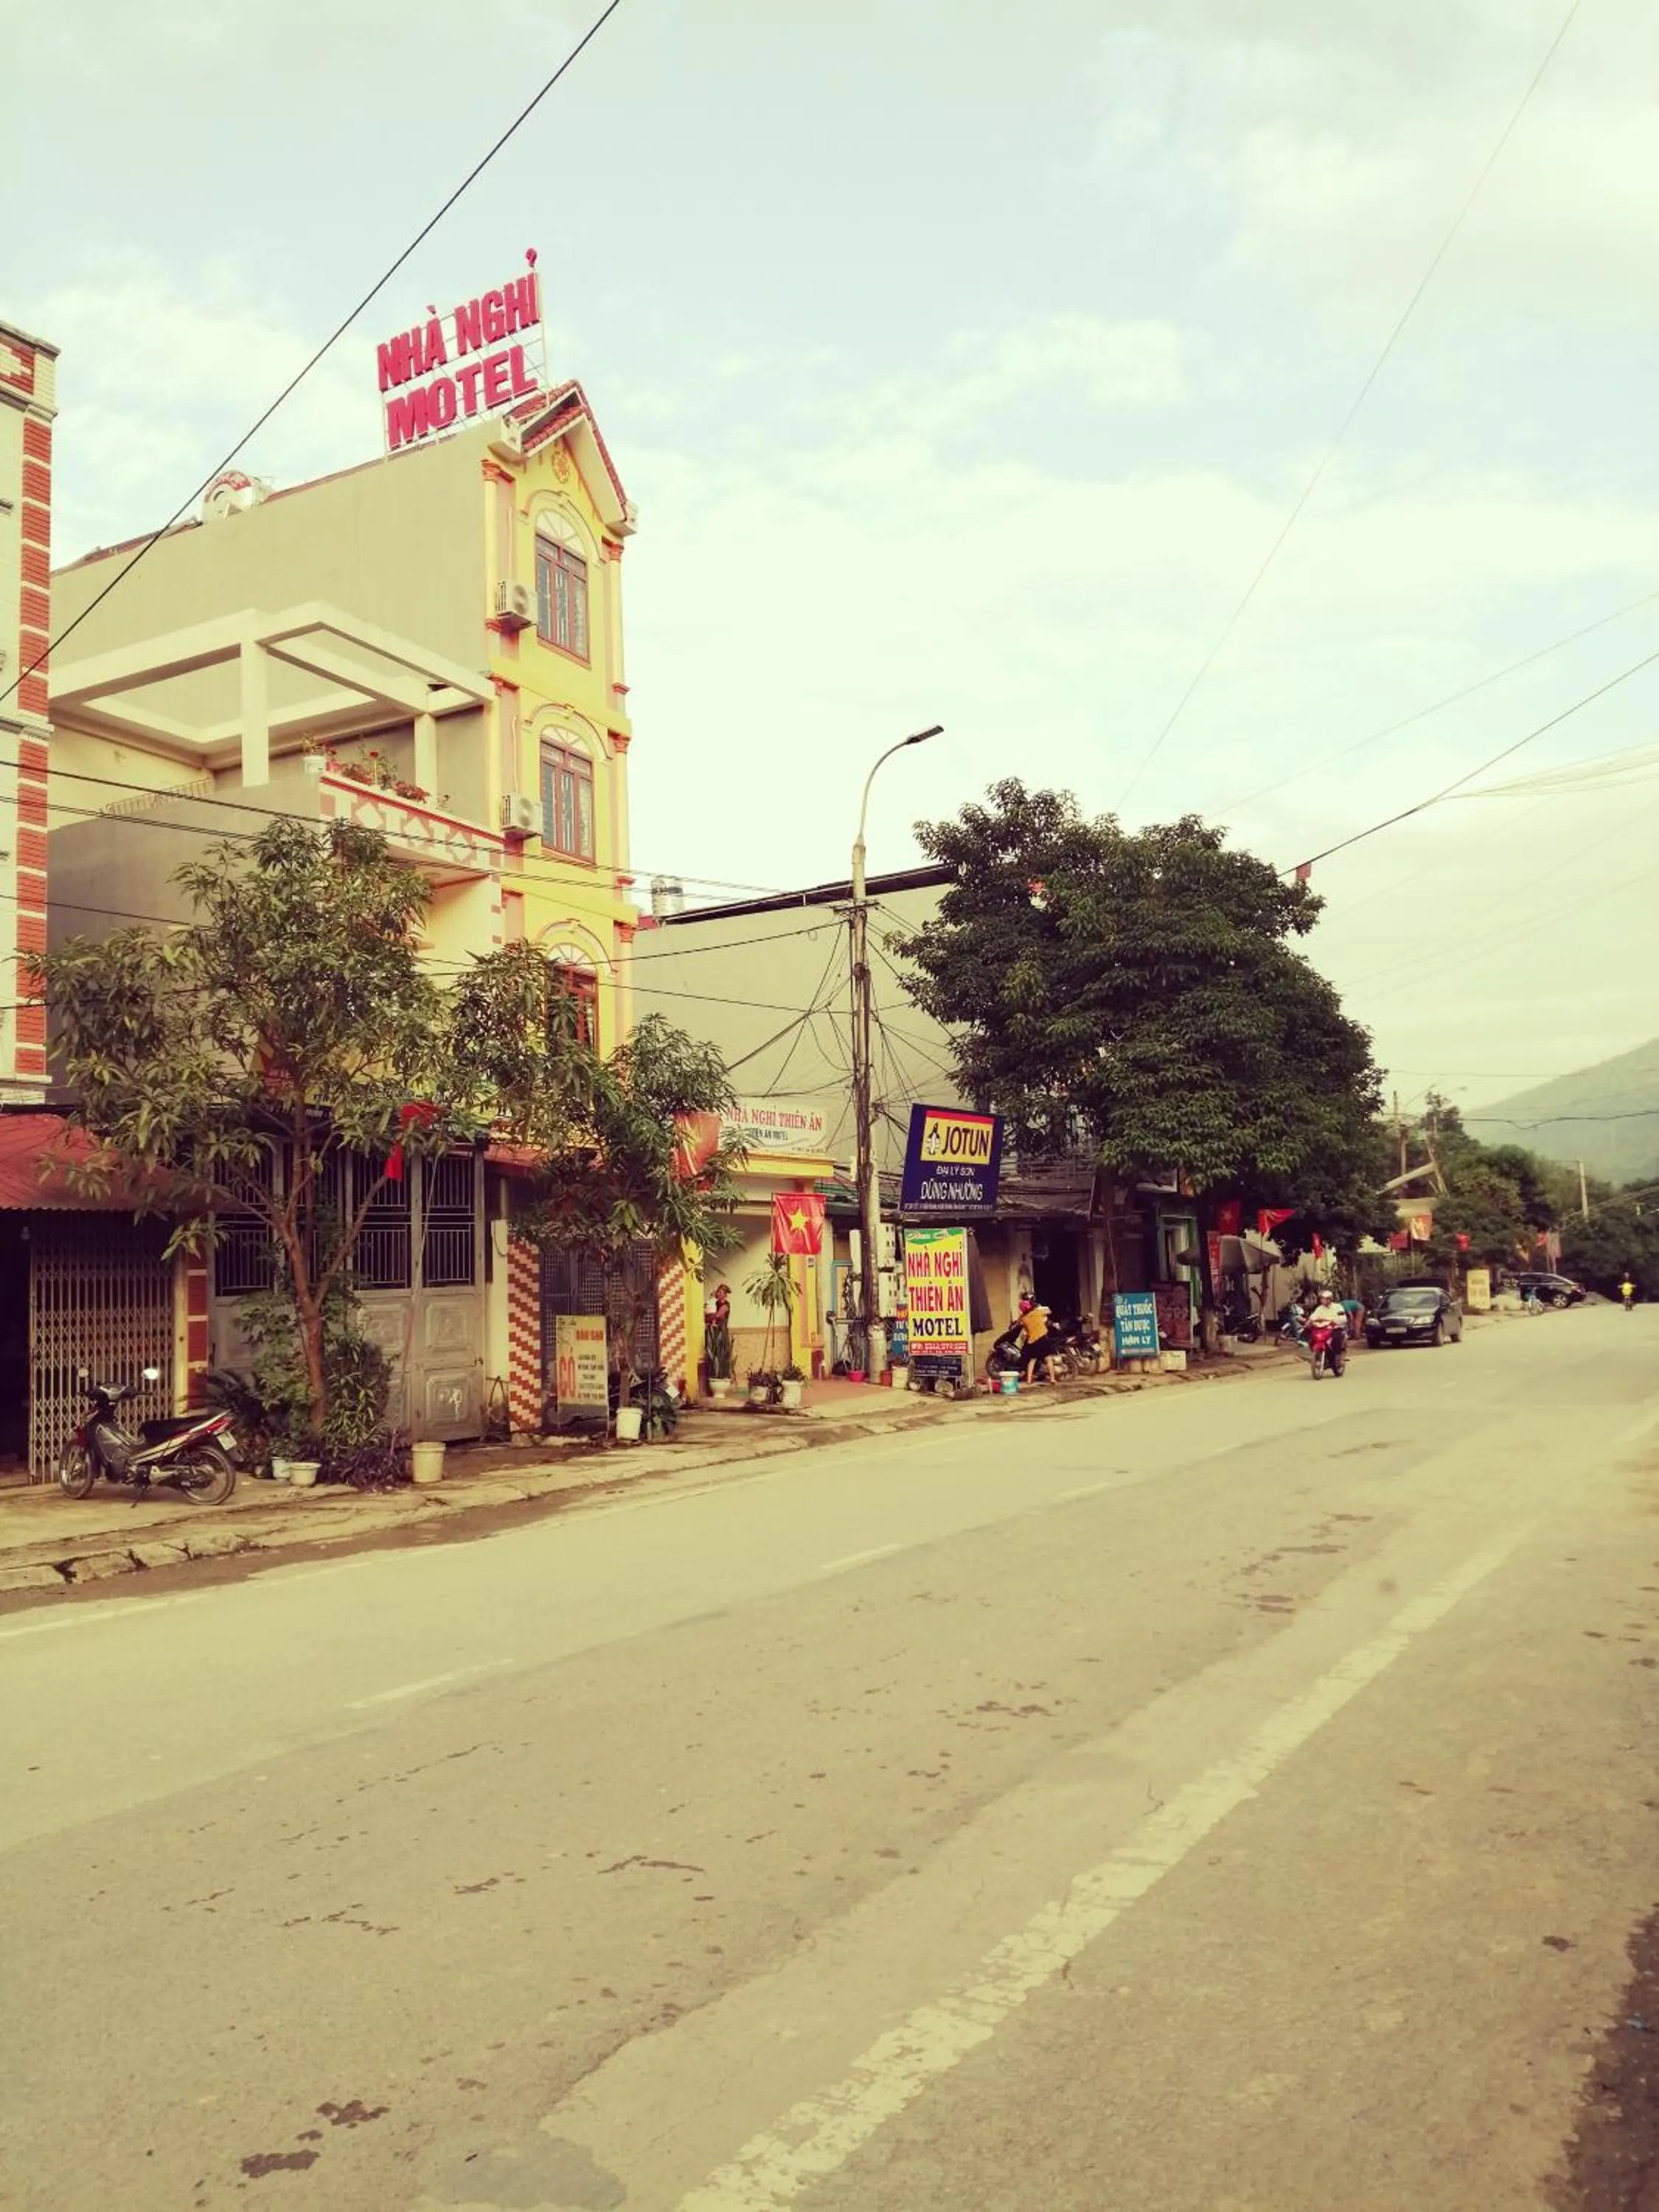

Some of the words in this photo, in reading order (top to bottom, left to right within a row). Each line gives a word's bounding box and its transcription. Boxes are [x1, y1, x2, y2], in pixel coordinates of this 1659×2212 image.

[377, 305, 448, 392] NHÀ
[454, 248, 540, 357] NGHỈ
[386, 344, 538, 451] MOTEL
[941, 1125, 990, 1158] JOTUN
[908, 1245, 931, 1278] NHÀ
[934, 1240, 963, 1278] NGHỈ
[913, 1318, 964, 1337] MOTEL
